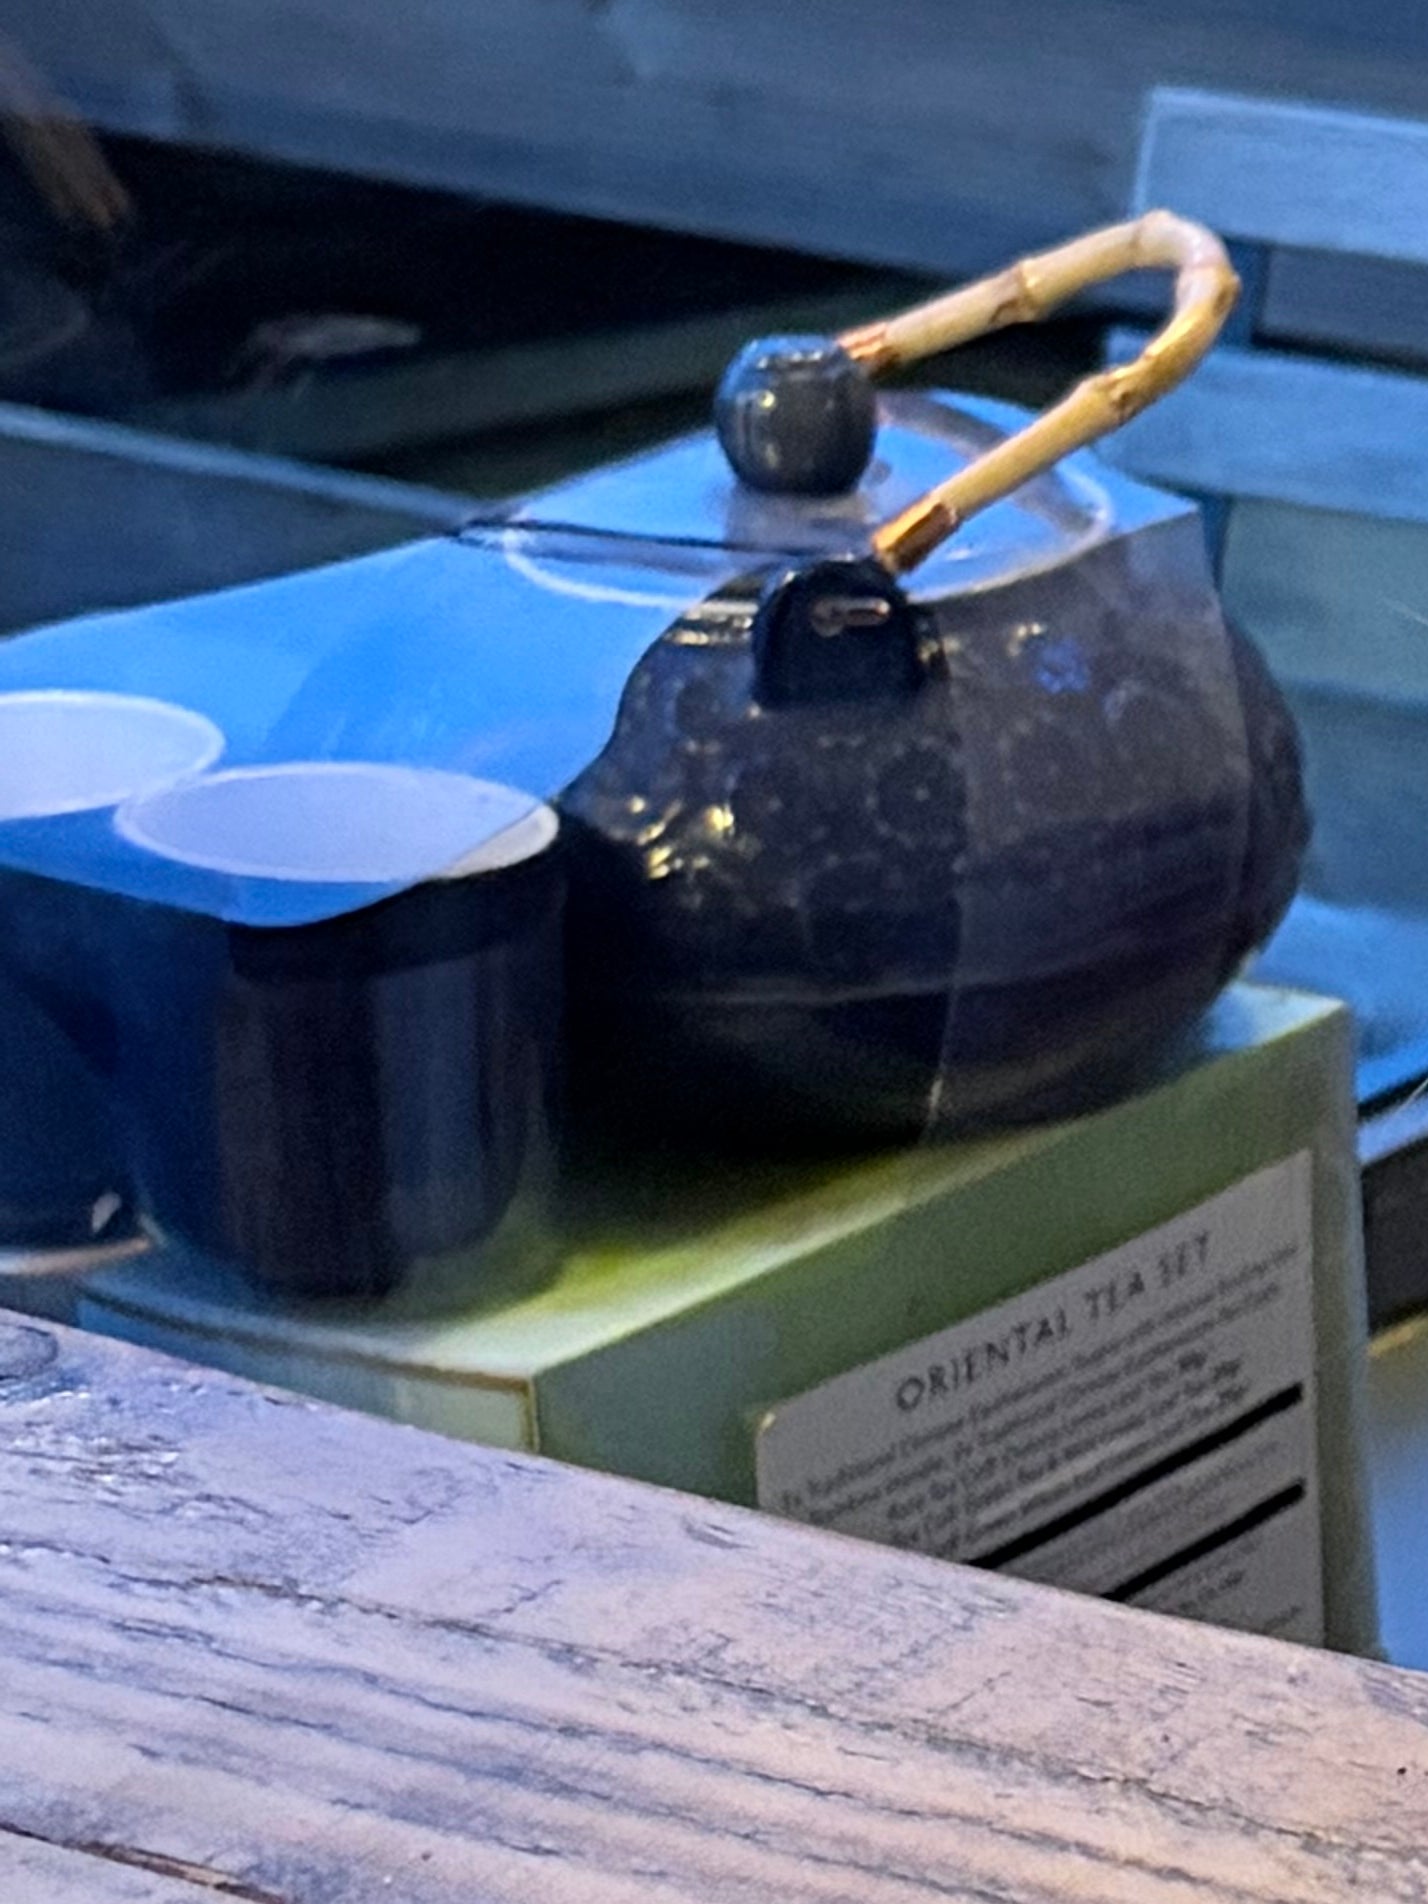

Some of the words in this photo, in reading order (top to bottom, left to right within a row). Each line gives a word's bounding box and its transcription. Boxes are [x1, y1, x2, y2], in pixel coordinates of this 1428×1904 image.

[896, 1305, 1070, 1412] ORIENTAL
[1083, 1270, 1146, 1321] TEA
[1157, 1230, 1209, 1288] SET
